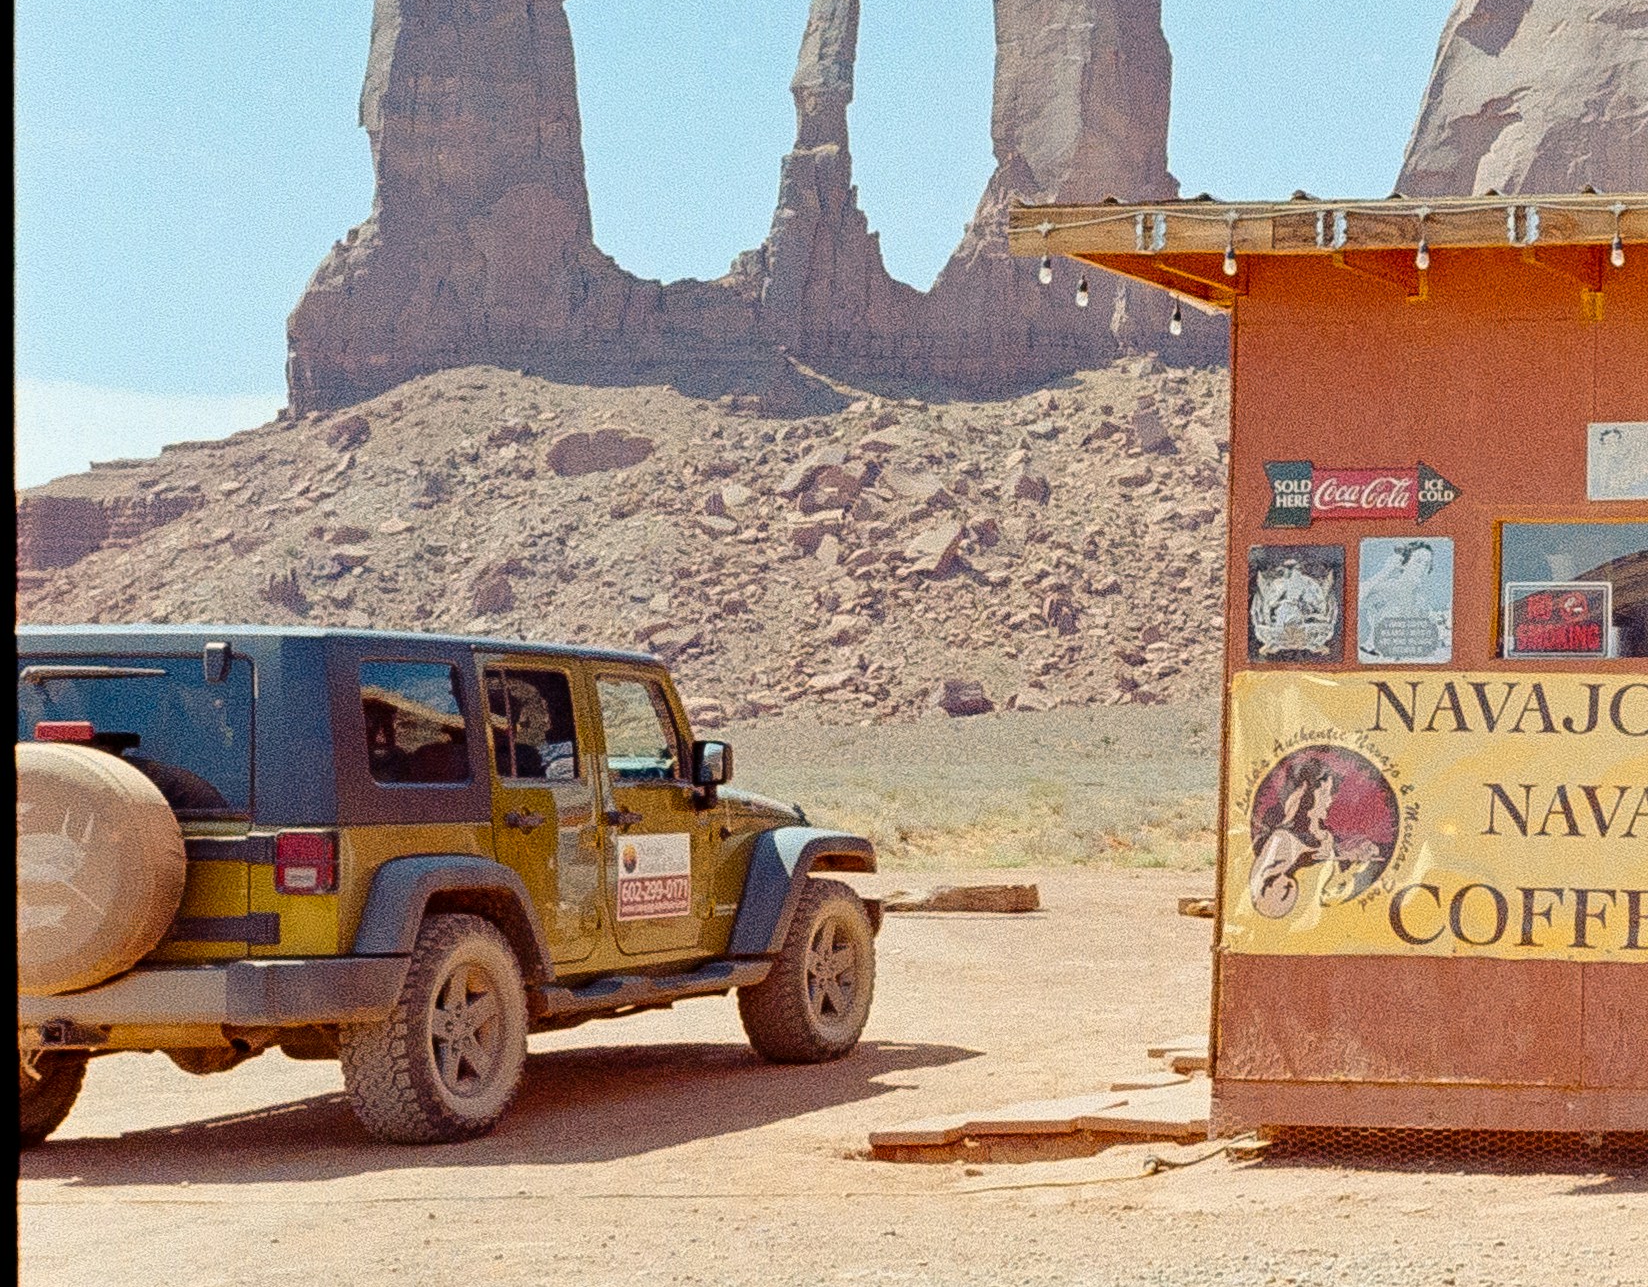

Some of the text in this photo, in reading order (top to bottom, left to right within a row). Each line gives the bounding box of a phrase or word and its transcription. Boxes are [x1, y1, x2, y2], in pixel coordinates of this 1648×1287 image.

[1274, 479, 1312, 492] SOLD
[1424, 479, 1444, 490] ICE
[1276, 495, 1311, 508] HERE
[1418, 490, 1455, 502] COLD
[1516, 624, 1600, 650] SMOKING
[1273, 726, 1347, 757] Authentic
[1355, 729, 1401, 778] Navajo
